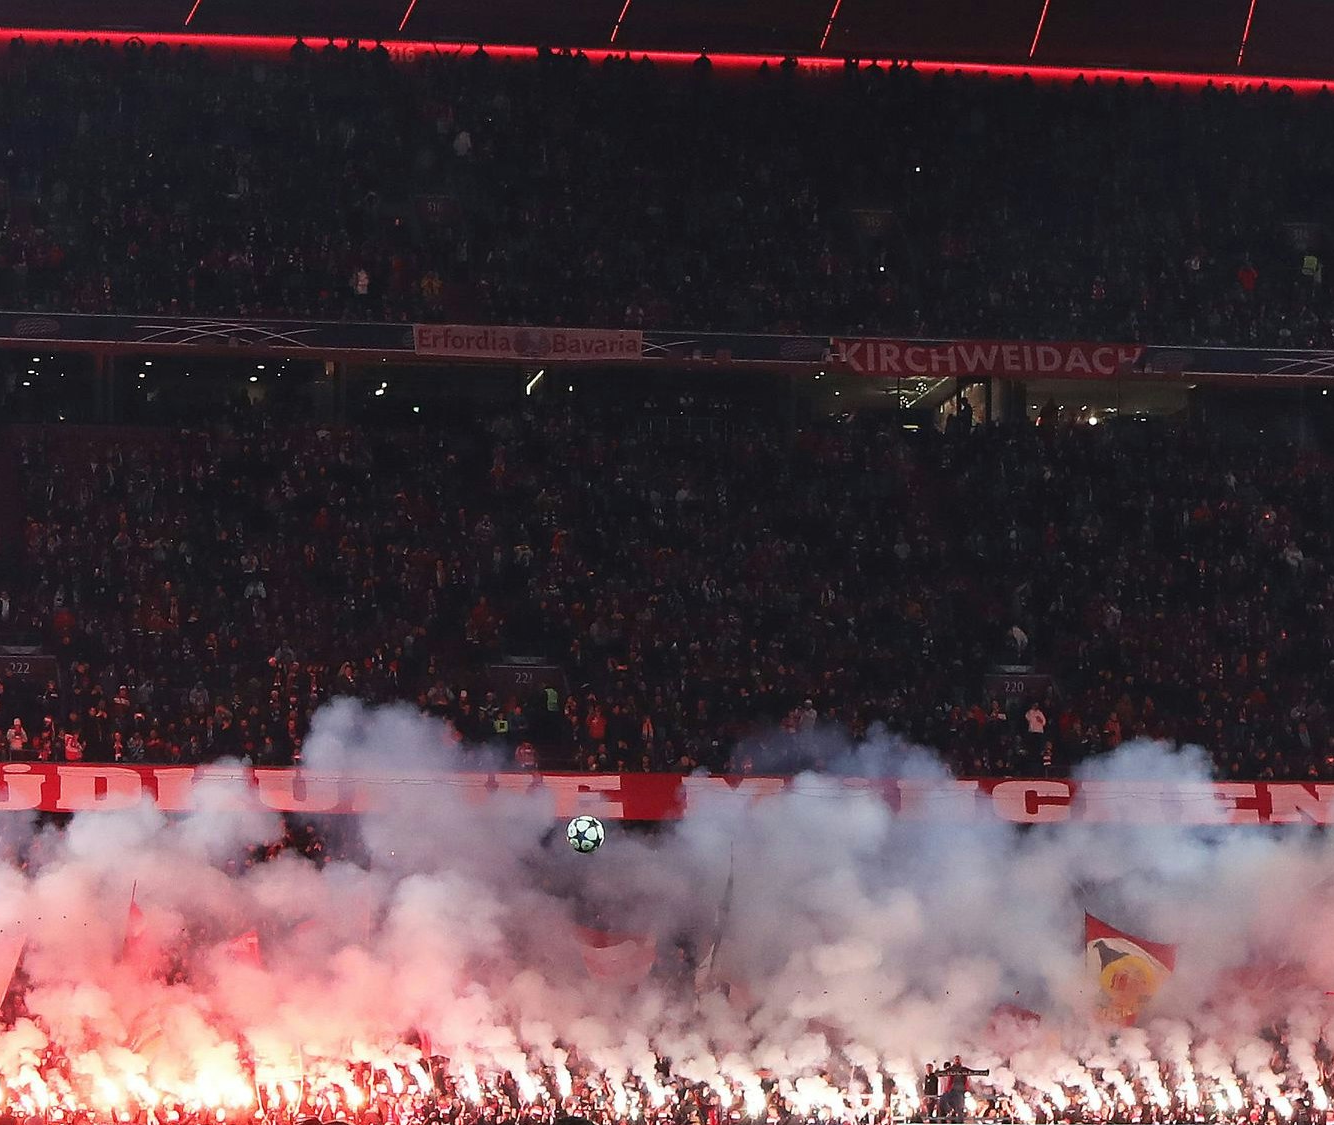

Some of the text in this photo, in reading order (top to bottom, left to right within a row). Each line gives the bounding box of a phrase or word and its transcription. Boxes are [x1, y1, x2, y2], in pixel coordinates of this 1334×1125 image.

[417, 325, 639, 356] Erfordia Bavaria
[835, 339, 1142, 375] KIRCHWEIDACH
